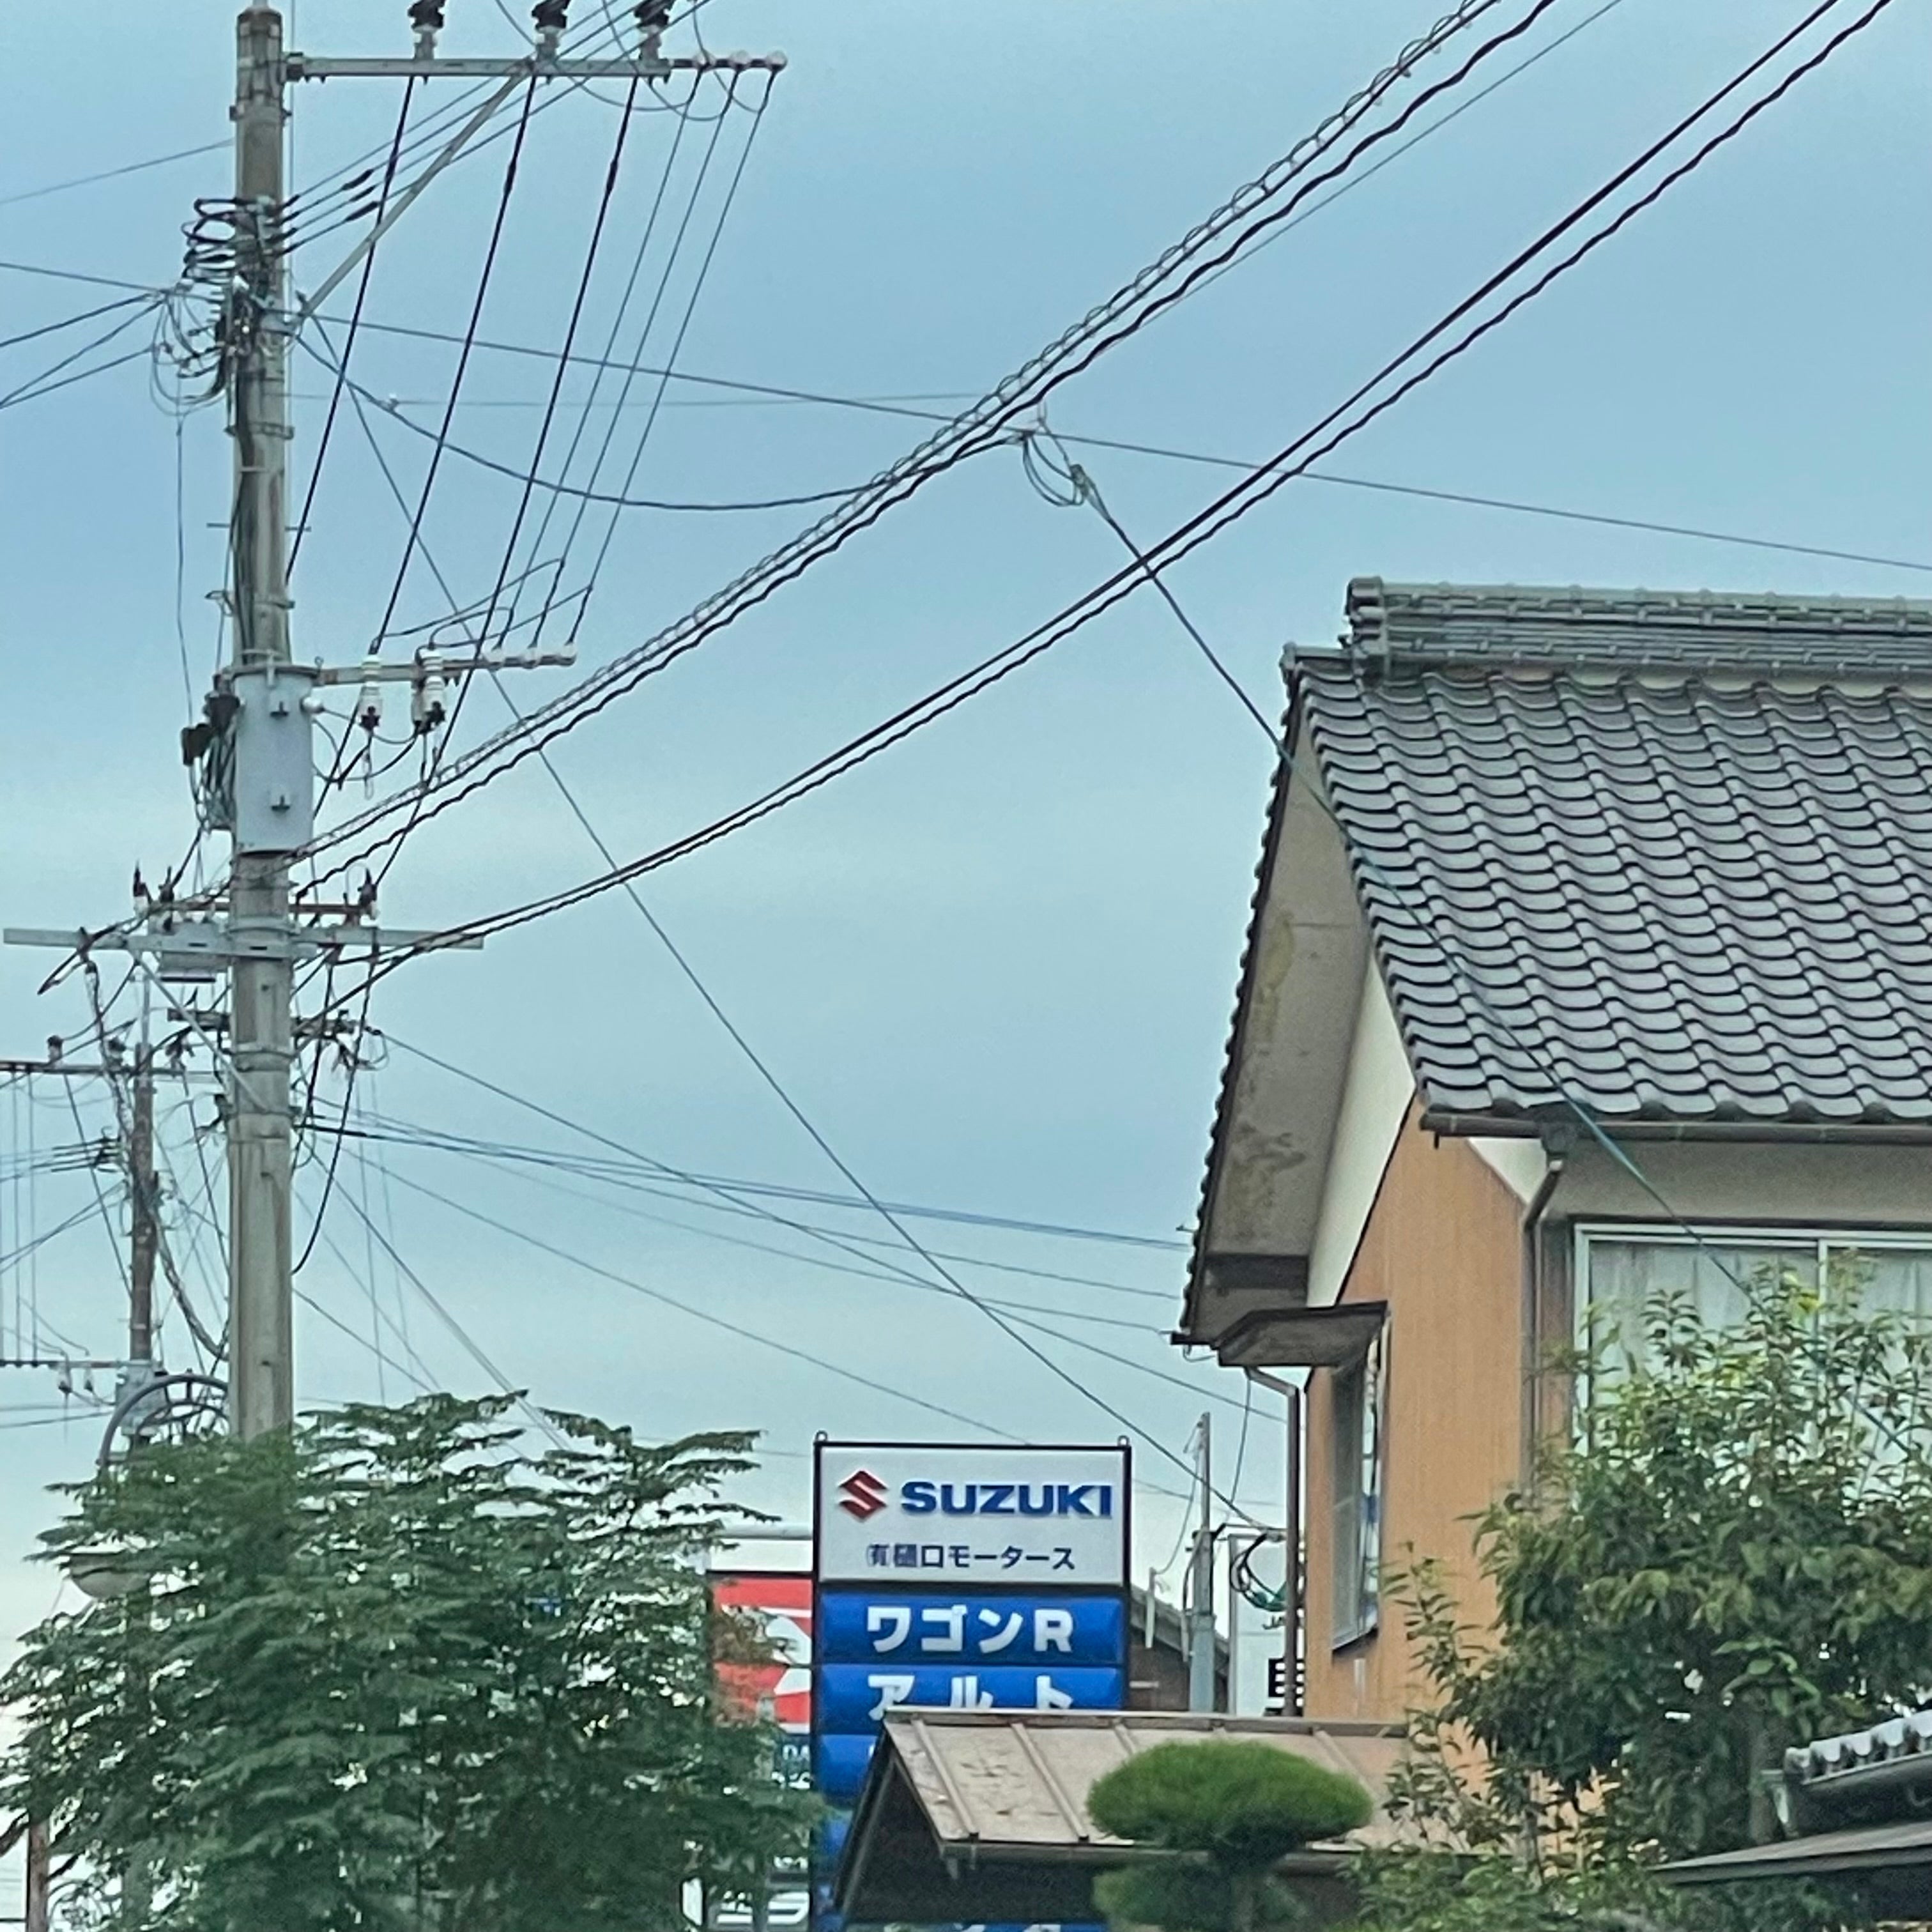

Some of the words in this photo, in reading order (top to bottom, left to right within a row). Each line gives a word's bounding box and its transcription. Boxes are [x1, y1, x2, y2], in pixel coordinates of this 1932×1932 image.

[901, 1481, 1112, 1517] SUZUKI
[867, 1604, 1073, 1653] ワゴンR
[868, 1675, 1073, 1721] アルト
